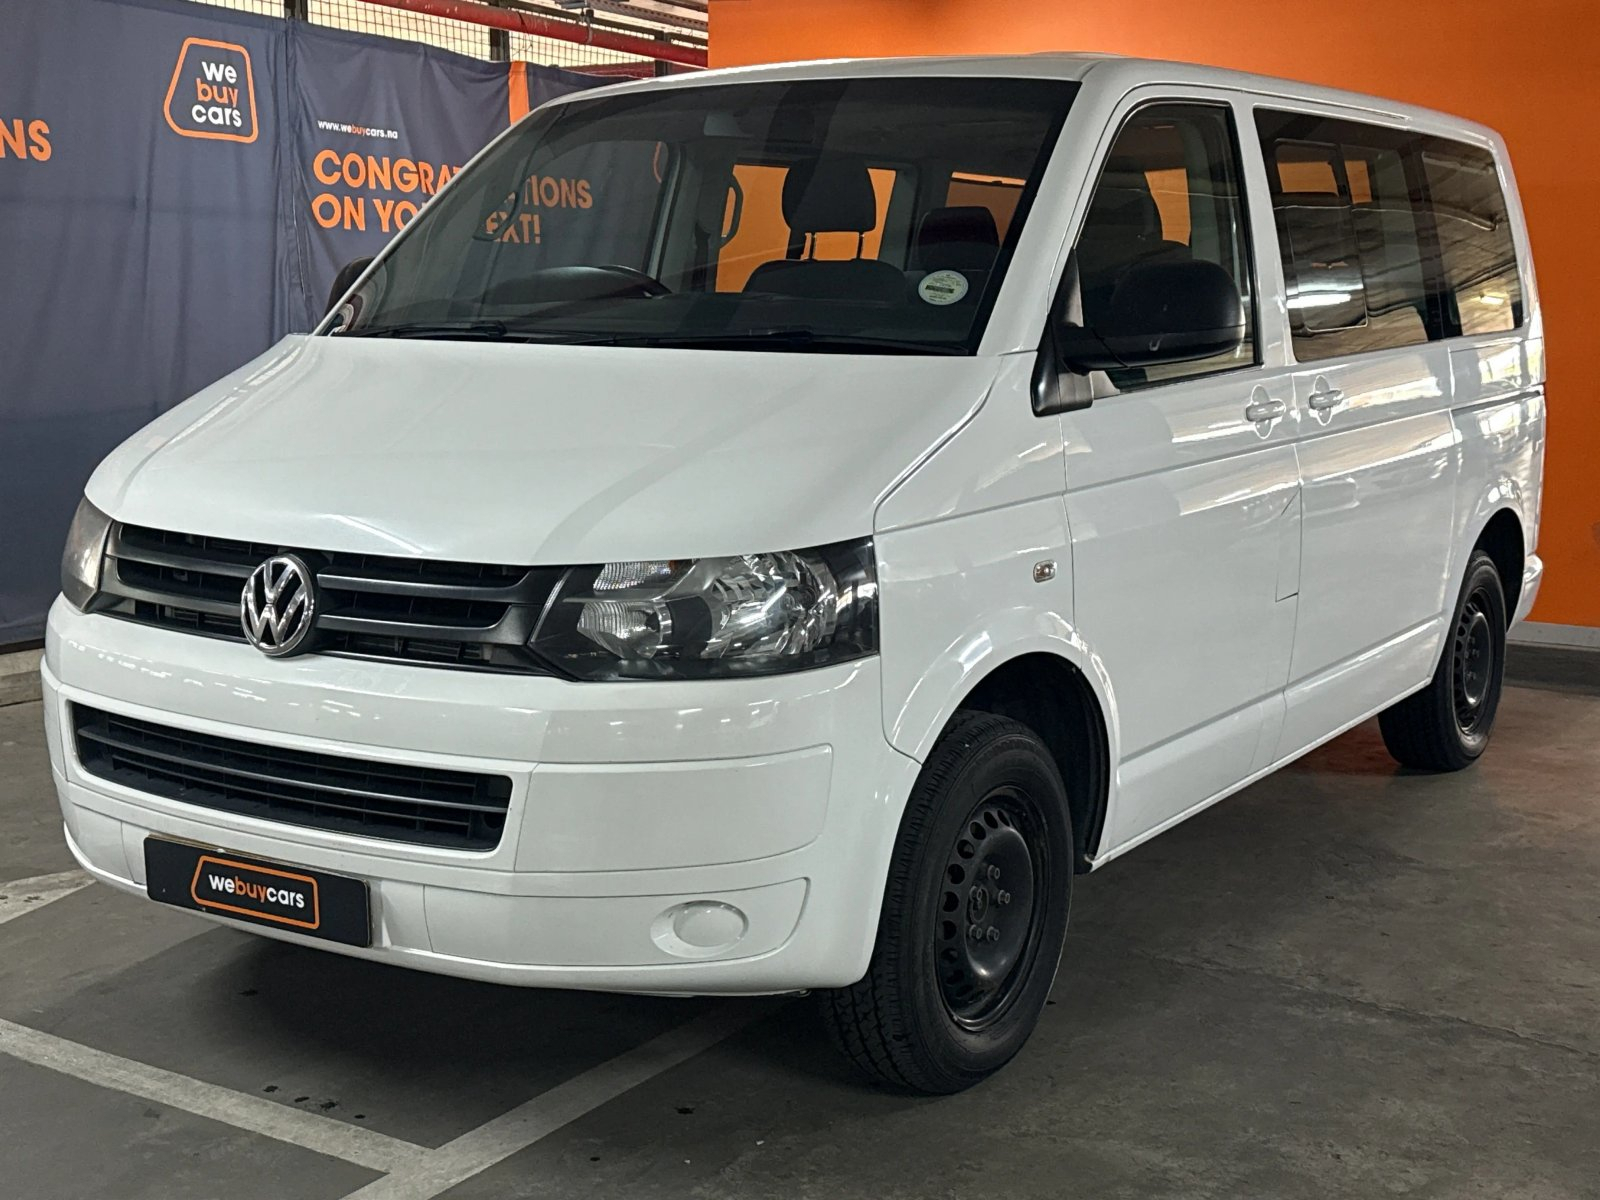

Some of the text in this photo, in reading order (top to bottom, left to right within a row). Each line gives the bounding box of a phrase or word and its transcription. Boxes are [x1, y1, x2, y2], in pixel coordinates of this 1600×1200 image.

[202, 61, 238, 84] we
[196, 78, 239, 108] buy
[191, 104, 242, 128] cars
[317, 120, 399, 140] www.webuycars.na
[311, 193, 366, 232] ON
[373, 198, 427, 233] YO
[208, 873, 306, 909] webuycars
